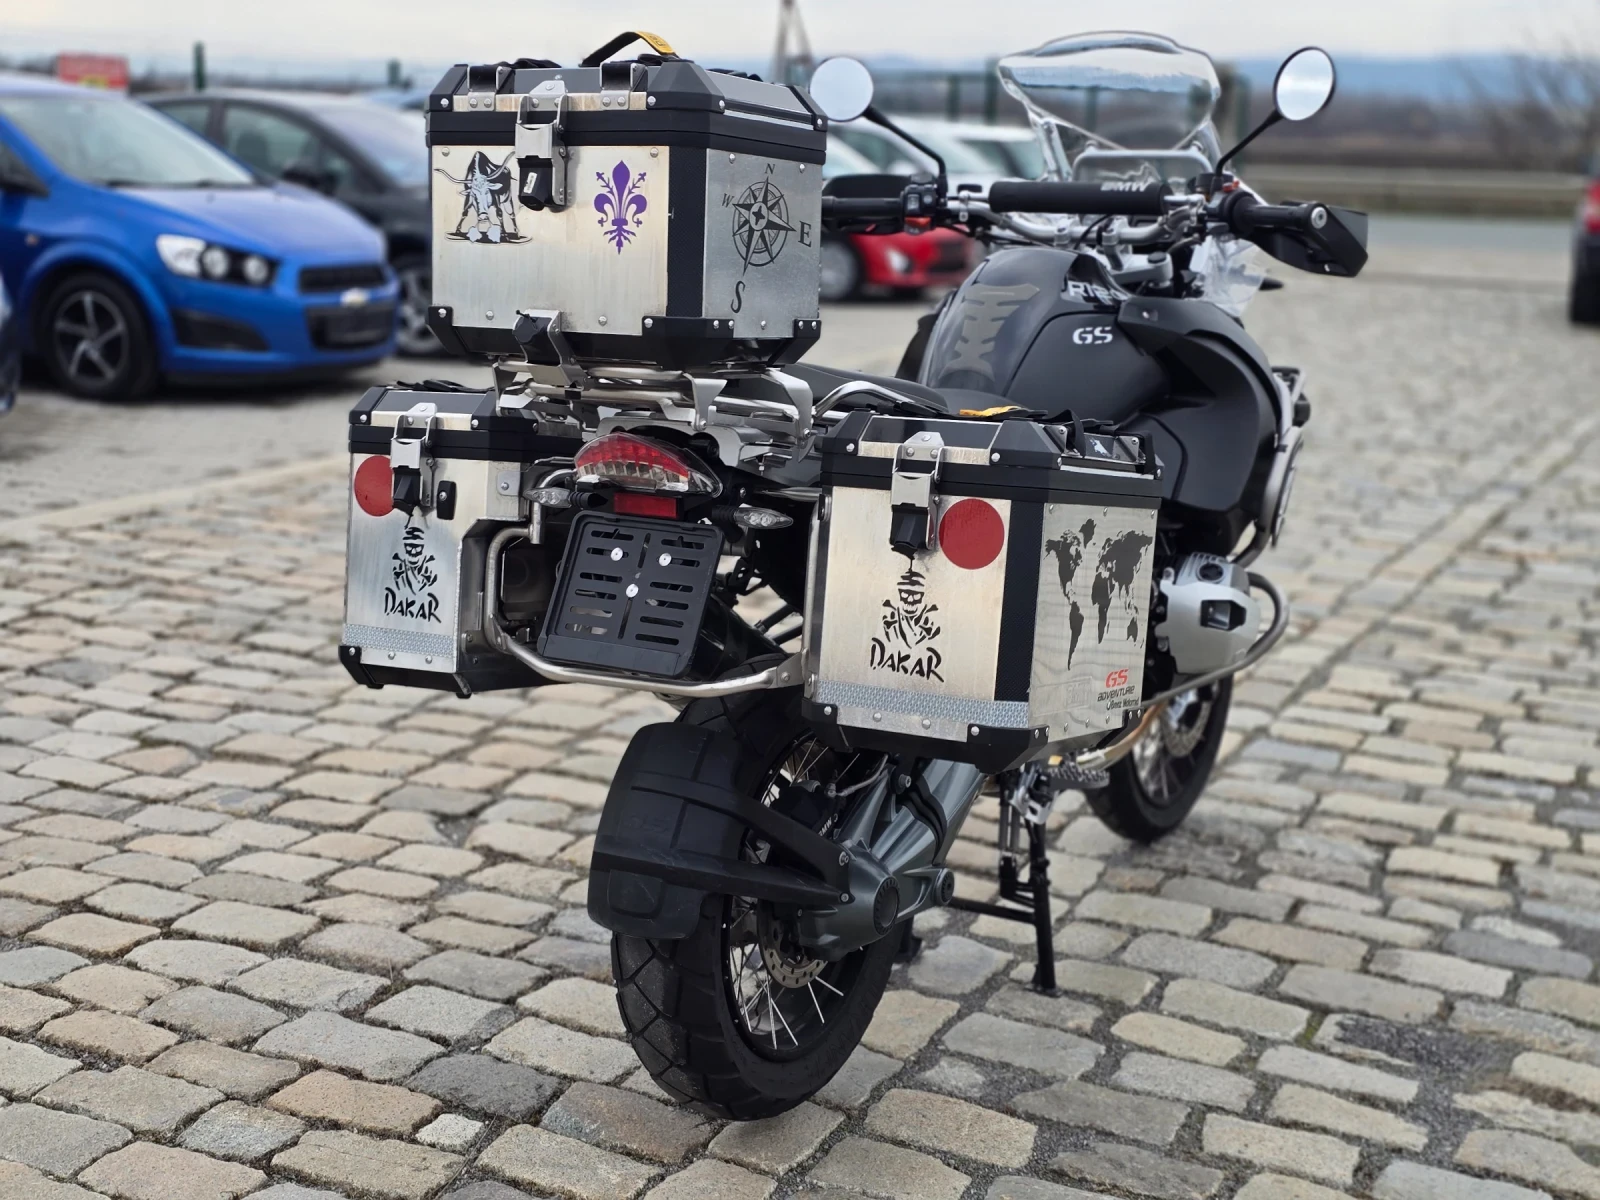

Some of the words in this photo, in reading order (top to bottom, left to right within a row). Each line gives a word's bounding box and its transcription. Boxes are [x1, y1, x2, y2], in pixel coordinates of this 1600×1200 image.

[764, 163, 775, 175] N
[721, 193, 735, 208] W
[798, 220, 812, 248] E
[730, 280, 746, 314] S
[1072, 326, 1113, 345] GS
[384, 586, 442, 624] DAKAR
[870, 636, 945, 683] DAKAR
[1105, 668, 1129, 688] GS
